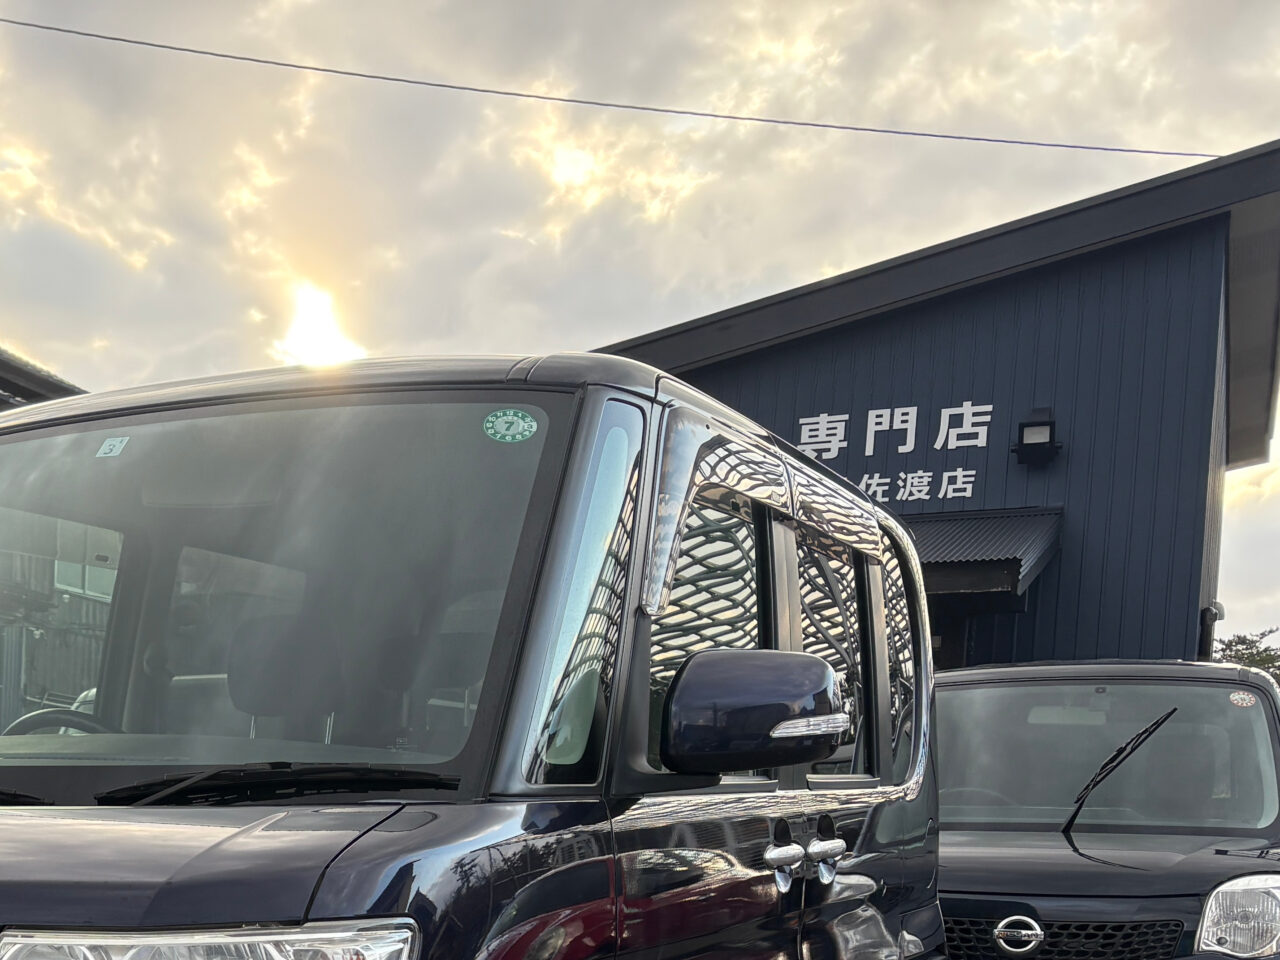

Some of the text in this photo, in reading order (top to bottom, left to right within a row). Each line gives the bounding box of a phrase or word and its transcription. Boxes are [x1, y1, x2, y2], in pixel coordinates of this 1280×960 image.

[504, 421, 515, 432] 7
[797, 400, 994, 460] 専門店
[858, 467, 977, 503] 佐渡店
